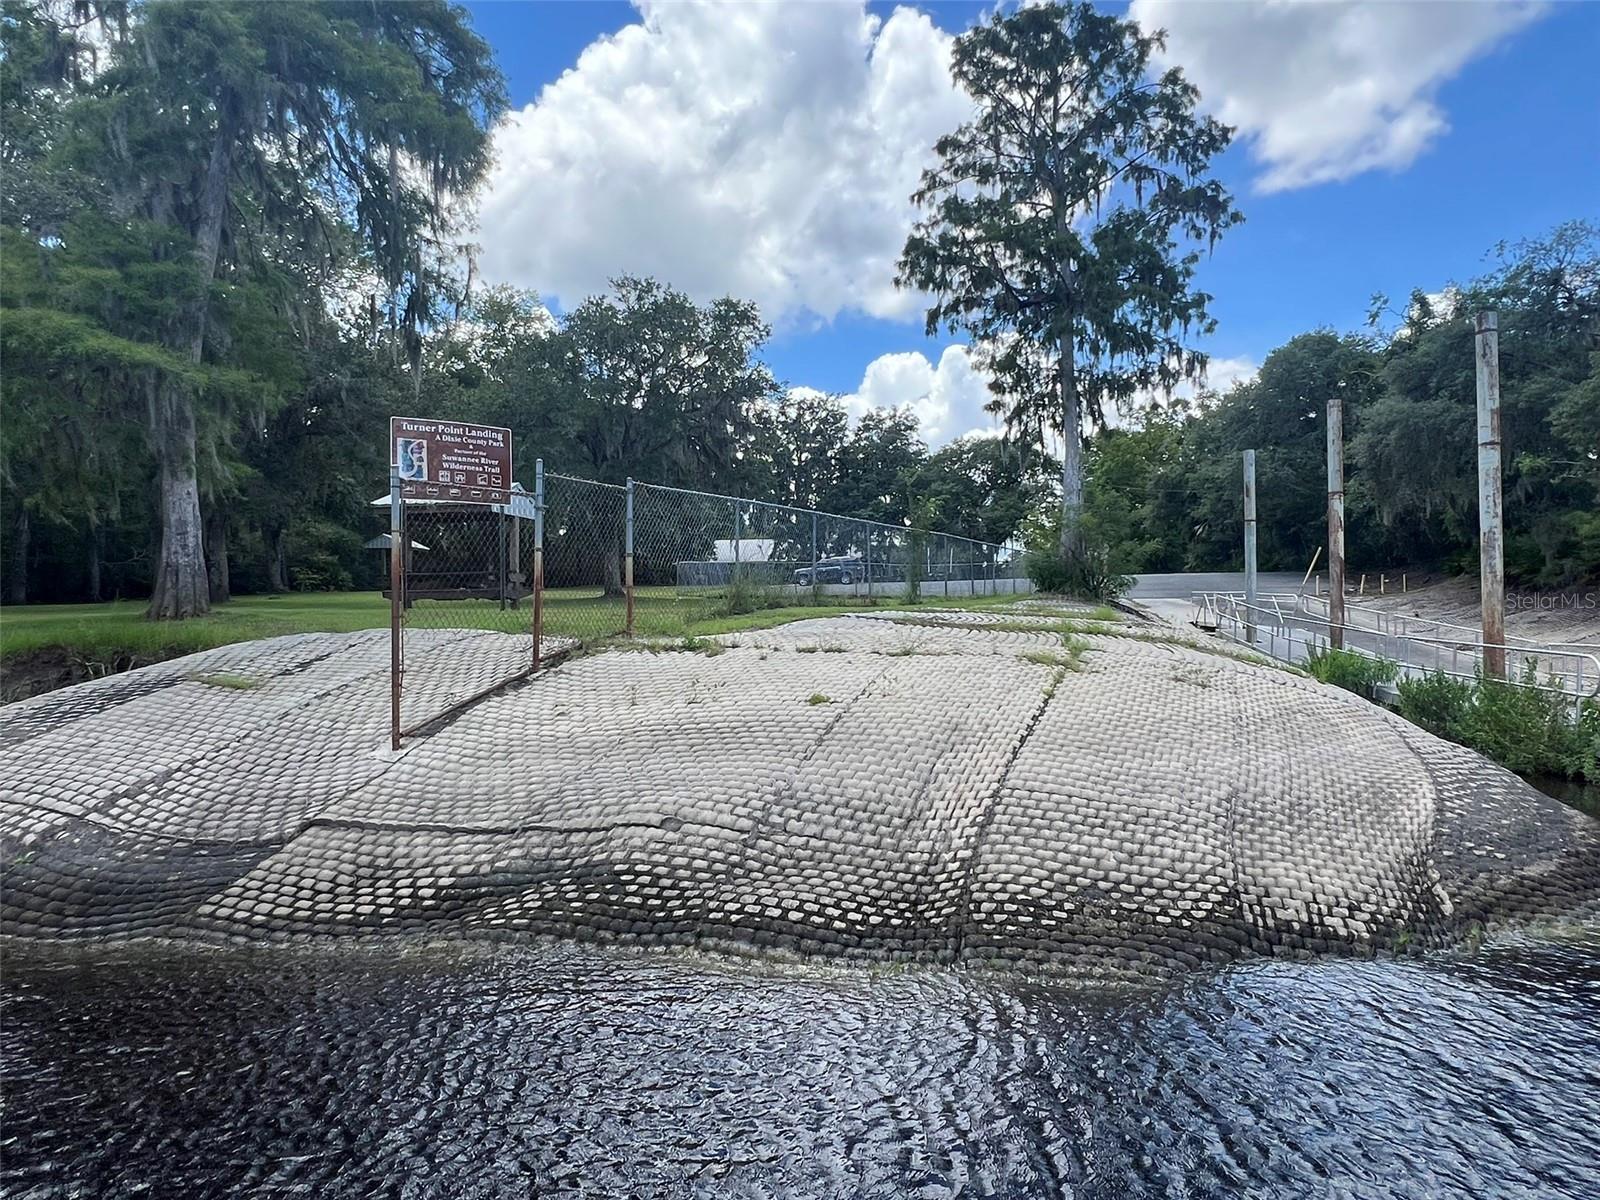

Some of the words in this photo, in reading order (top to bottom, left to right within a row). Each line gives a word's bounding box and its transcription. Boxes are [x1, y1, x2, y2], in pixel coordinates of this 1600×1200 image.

[401, 422, 436, 432] Turner
[438, 426, 464, 434] Point
[466, 428, 504, 440] Landing
[463, 437, 487, 446] County
[442, 454, 479, 462] Suwannee
[442, 462, 483, 471] Wilderness
